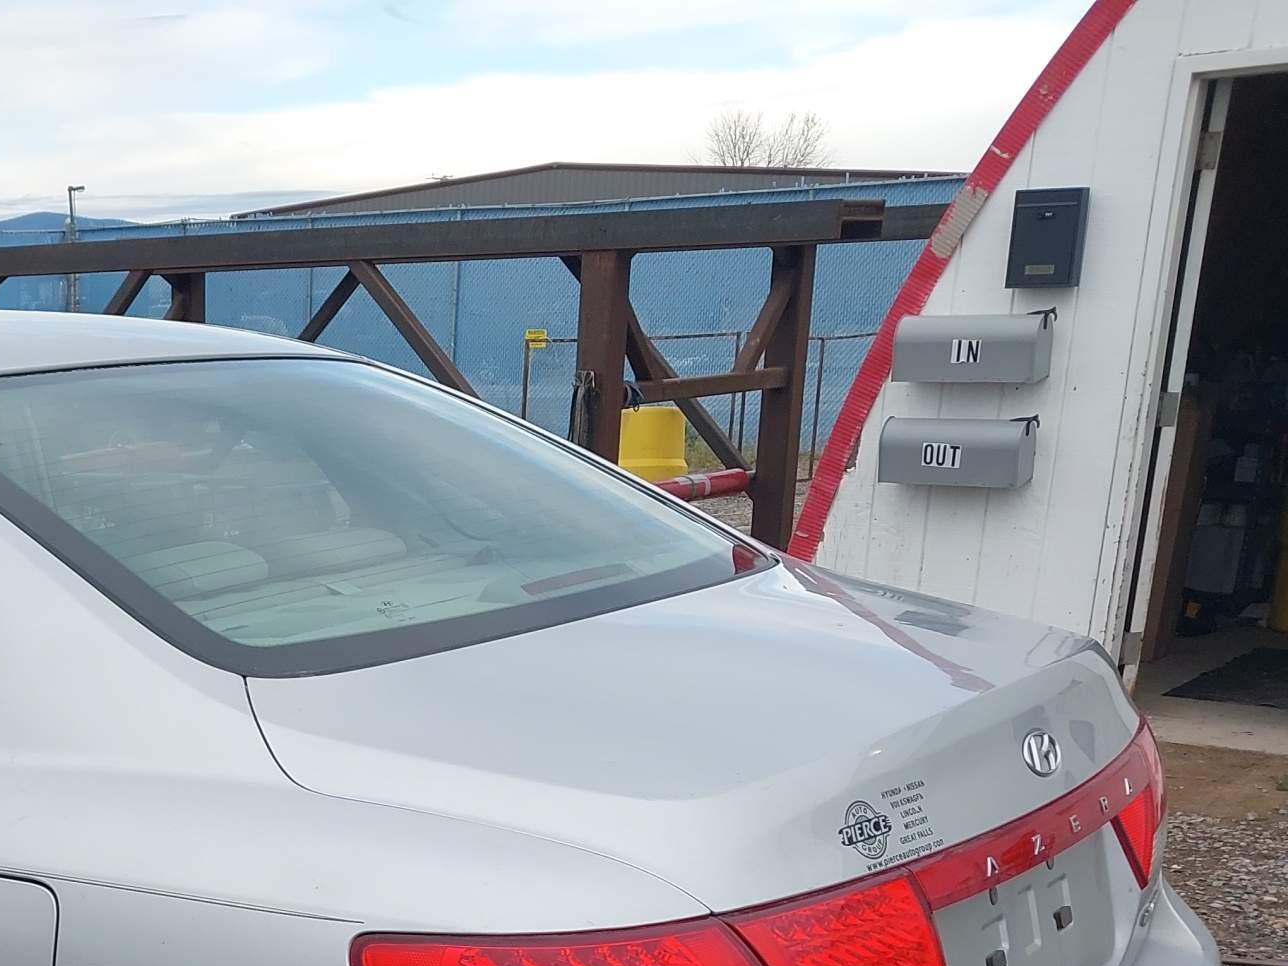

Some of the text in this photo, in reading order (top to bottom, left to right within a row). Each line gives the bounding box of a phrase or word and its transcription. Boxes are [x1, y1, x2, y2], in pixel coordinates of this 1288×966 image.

[956, 340, 979, 362] IN
[923, 443, 960, 467] OUT
[852, 806, 868, 818] AUTO
[842, 816, 889, 846] PIERCE
[903, 816, 929, 830] MERCURY
[986, 777, 1133, 877] AZERA
[860, 838, 884, 853] GROUP
[899, 827, 934, 845] GREAT FALLS
